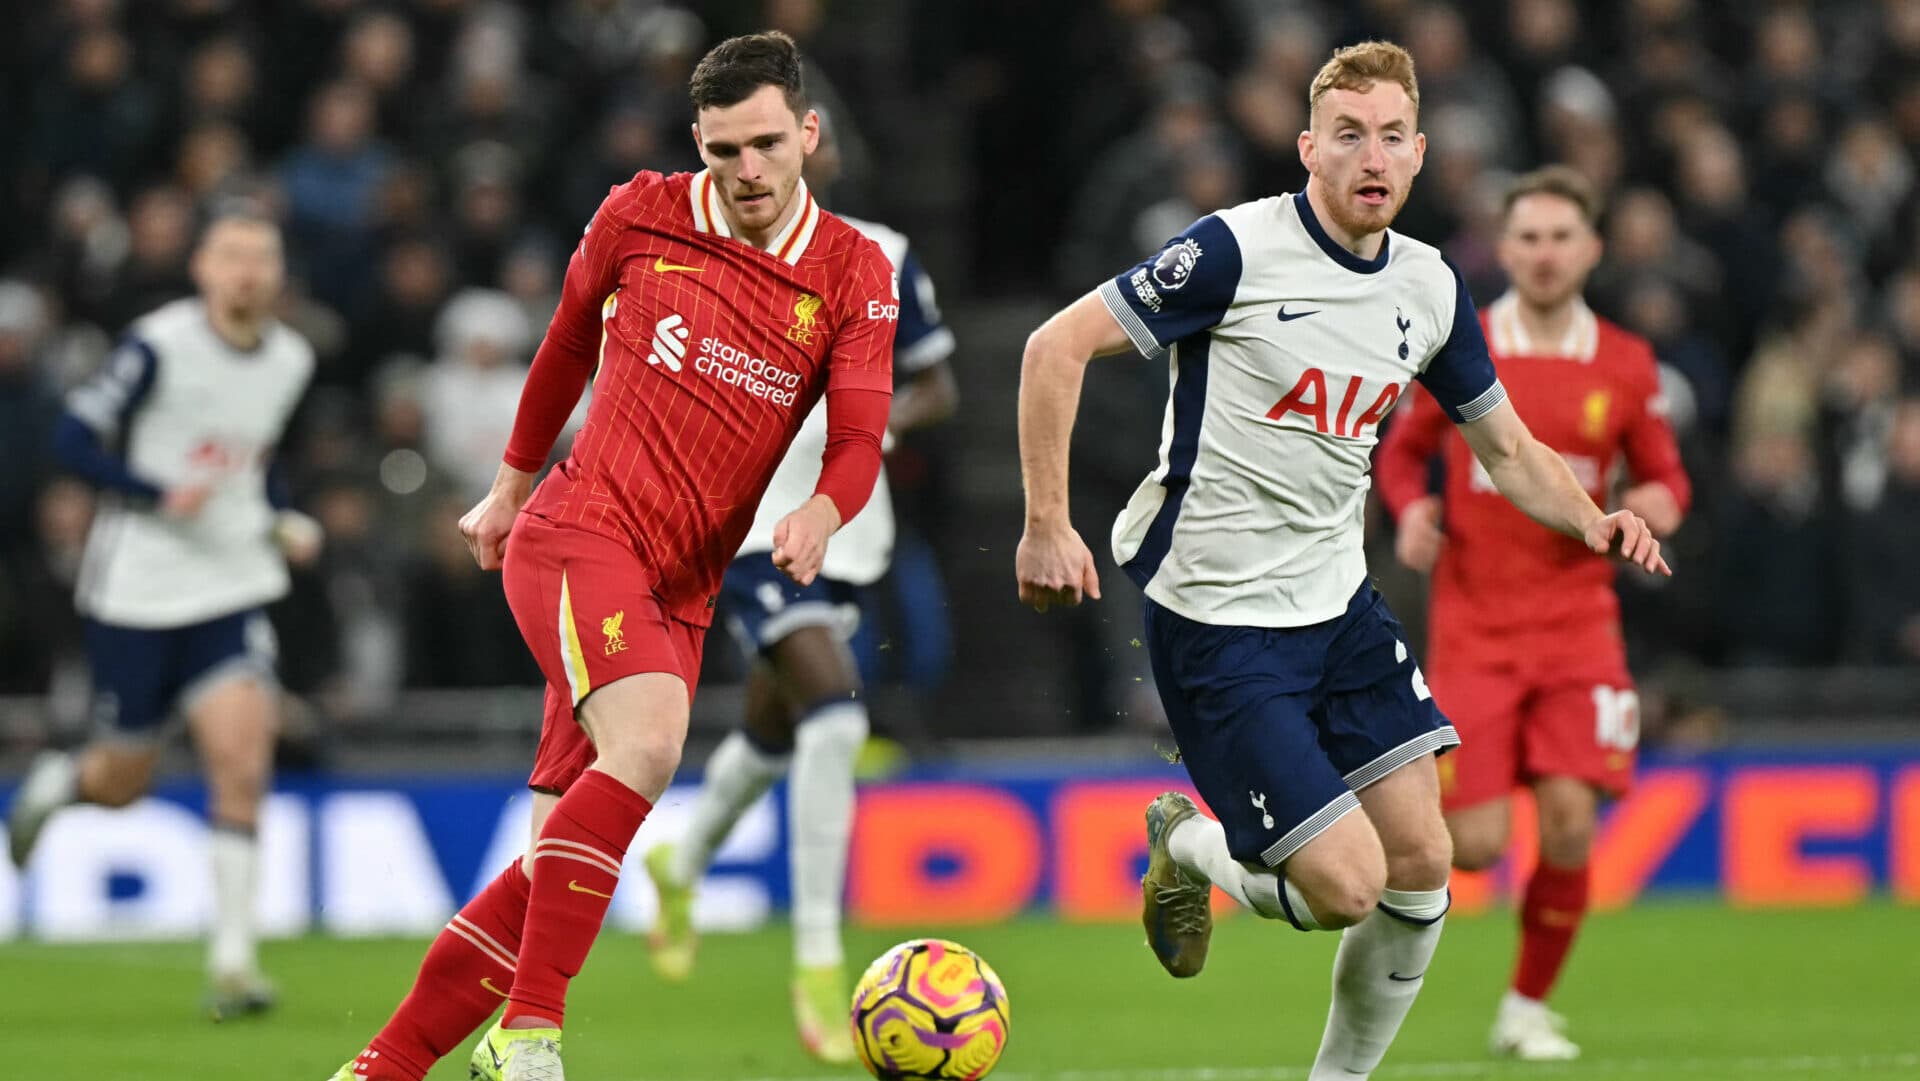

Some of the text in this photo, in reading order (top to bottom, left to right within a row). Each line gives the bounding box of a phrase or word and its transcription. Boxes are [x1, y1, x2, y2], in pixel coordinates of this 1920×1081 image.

[868, 300, 899, 323] Exp
[695, 356, 798, 407] chartered
[700, 337, 802, 389] standard
[1265, 367, 1400, 438] AIA
[1593, 685, 1640, 752] 10
